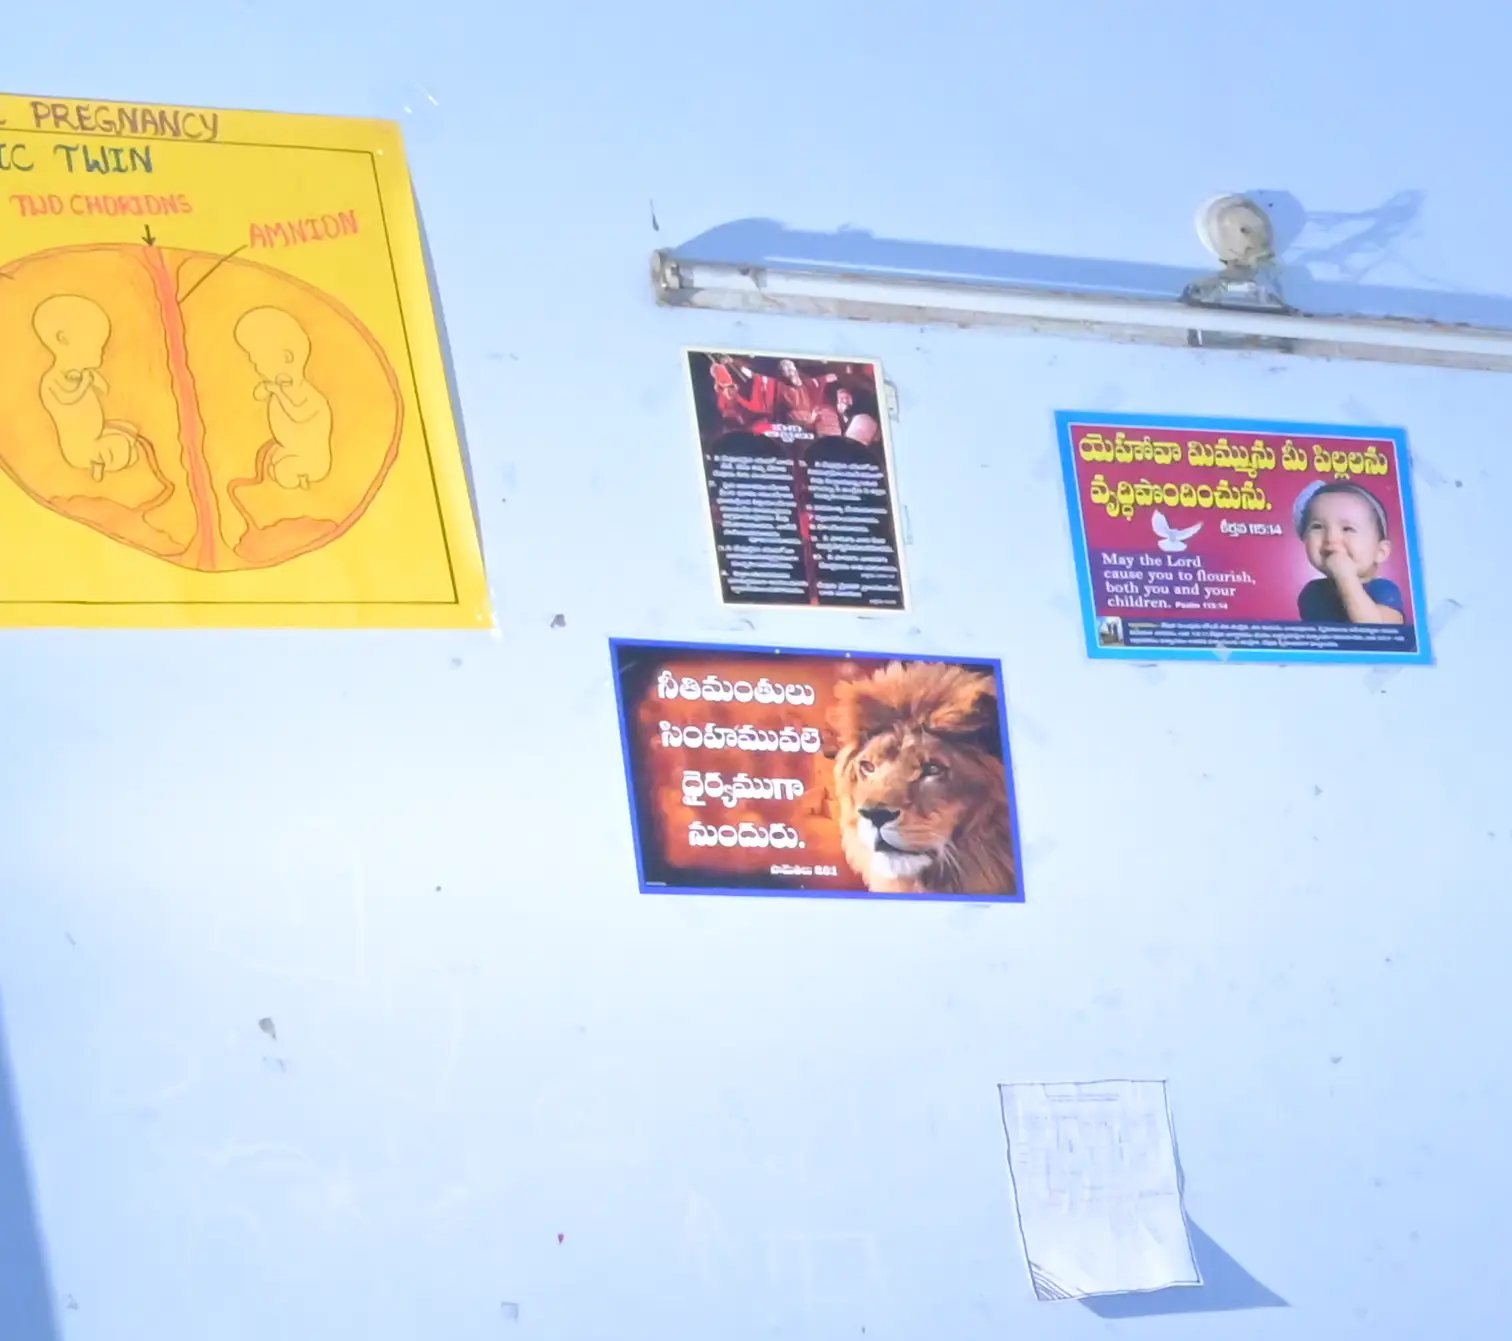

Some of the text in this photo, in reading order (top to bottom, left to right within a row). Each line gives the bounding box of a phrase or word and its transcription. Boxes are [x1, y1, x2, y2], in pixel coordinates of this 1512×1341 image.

[30, 101, 218, 141] PREGNANCY
[54, 144, 153, 174] TWIN
[248, 210, 359, 248] AMNION
[1101, 553, 1202, 569] May the Lord
[1104, 569, 1256, 585] cause you to flourish,
[1106, 581, 1236, 599] both you and your
[1108, 595, 1172, 609] children.
[658, 670, 815, 705] నీతిమంతులు
